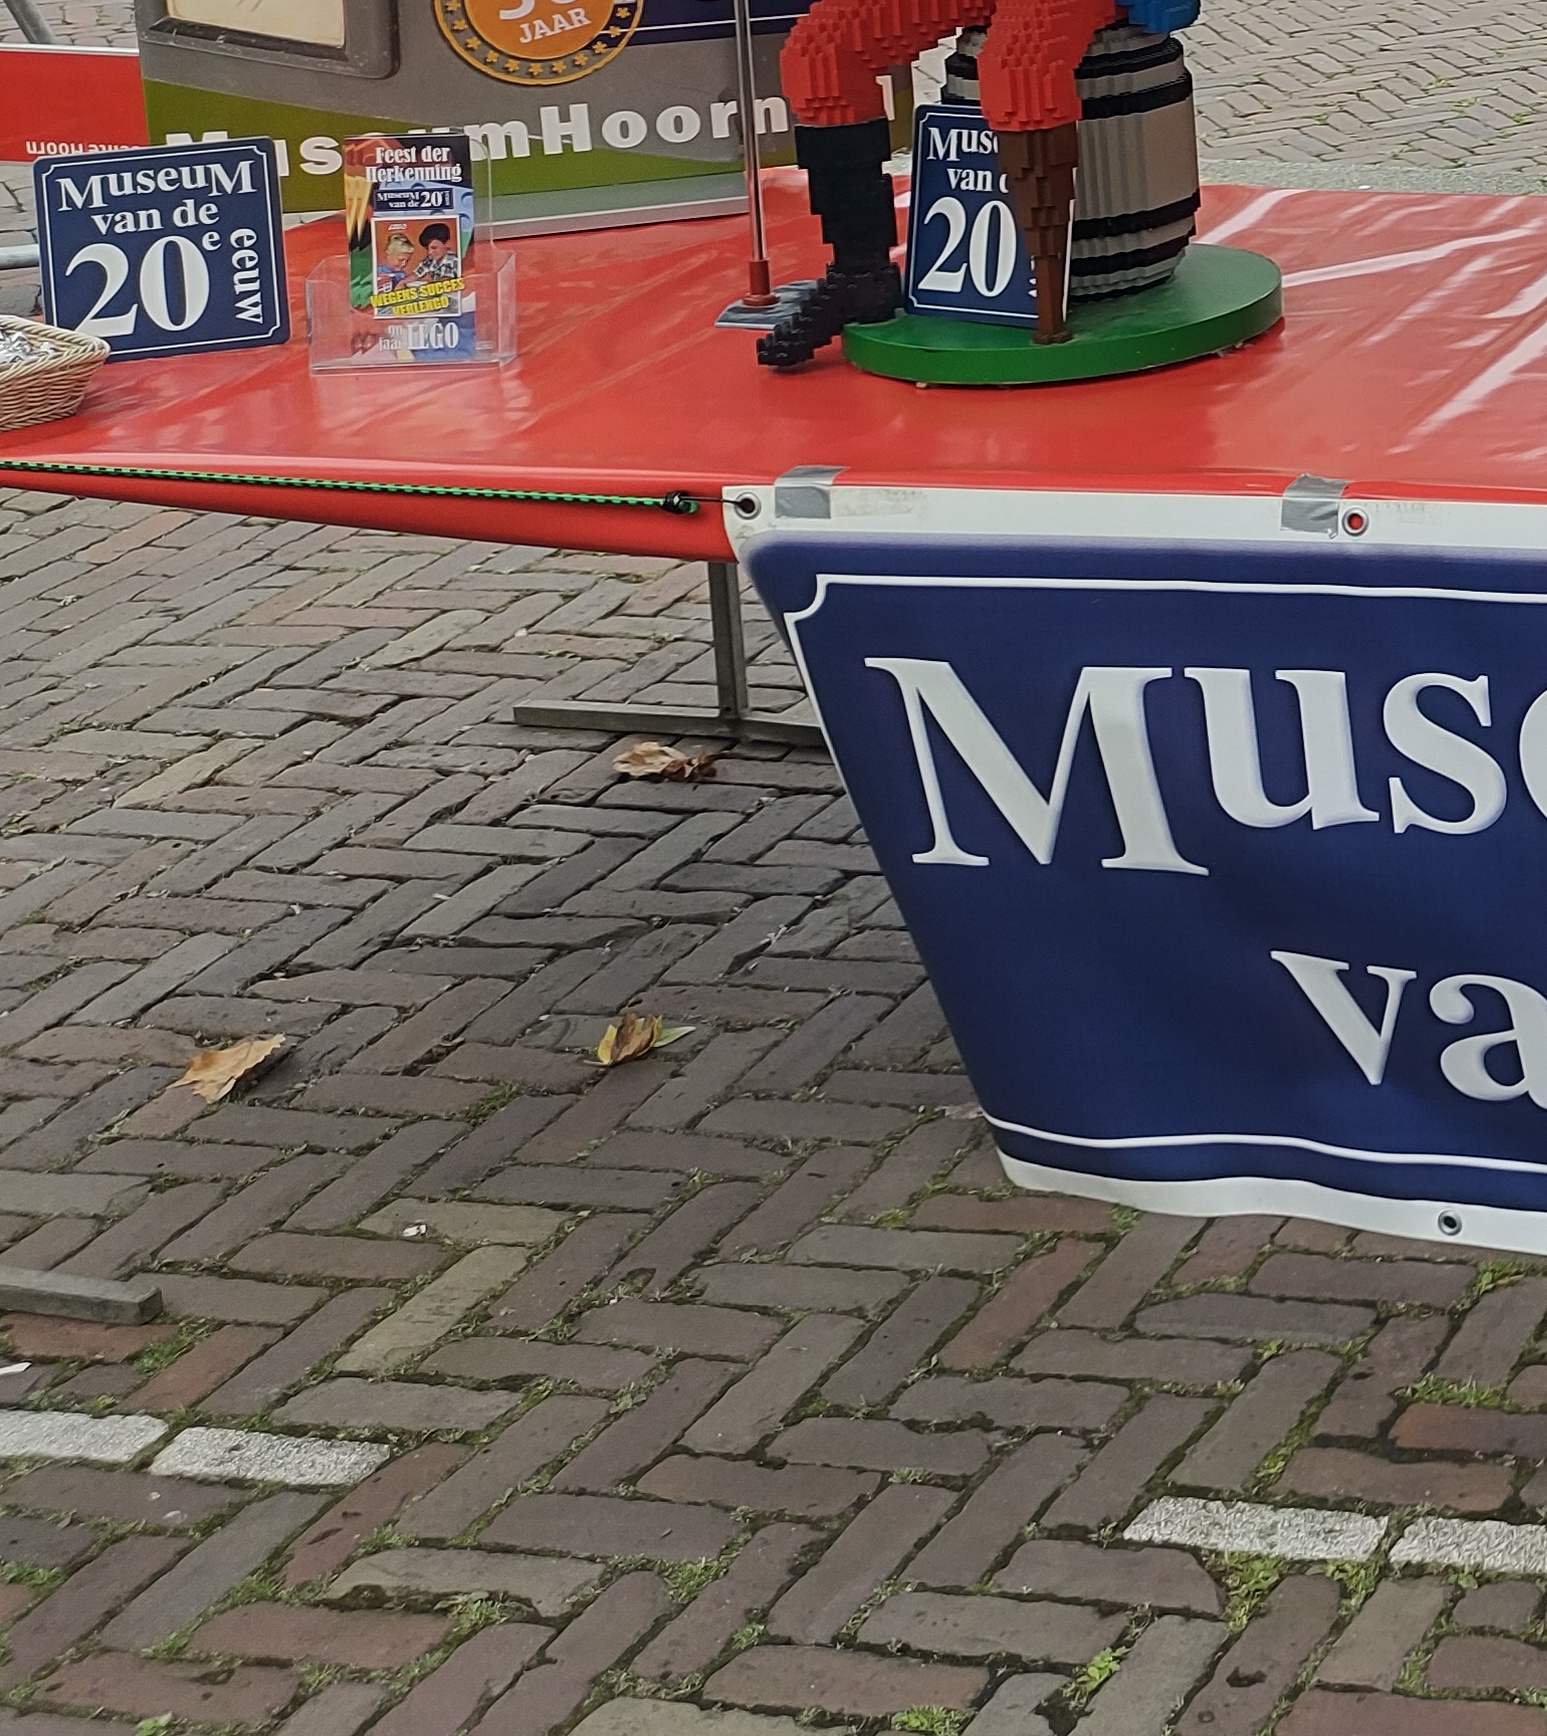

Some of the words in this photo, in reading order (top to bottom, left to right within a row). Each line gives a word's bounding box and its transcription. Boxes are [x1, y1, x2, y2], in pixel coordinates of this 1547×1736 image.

[519, 8, 591, 44] JAAR
[375, 145, 417, 163] Feest
[421, 145, 450, 163] der
[55, 160, 258, 212] MuseuM
[365, 164, 462, 184] Herkenning
[947, 167, 993, 193] van
[91, 208, 164, 235] van
[172, 198, 220, 227] de
[917, 196, 1018, 298] 20
[65, 235, 210, 337] 20
[202, 231, 222, 251] e
[229, 228, 264, 324] eeuw
[406, 322, 459, 350] LEGO
